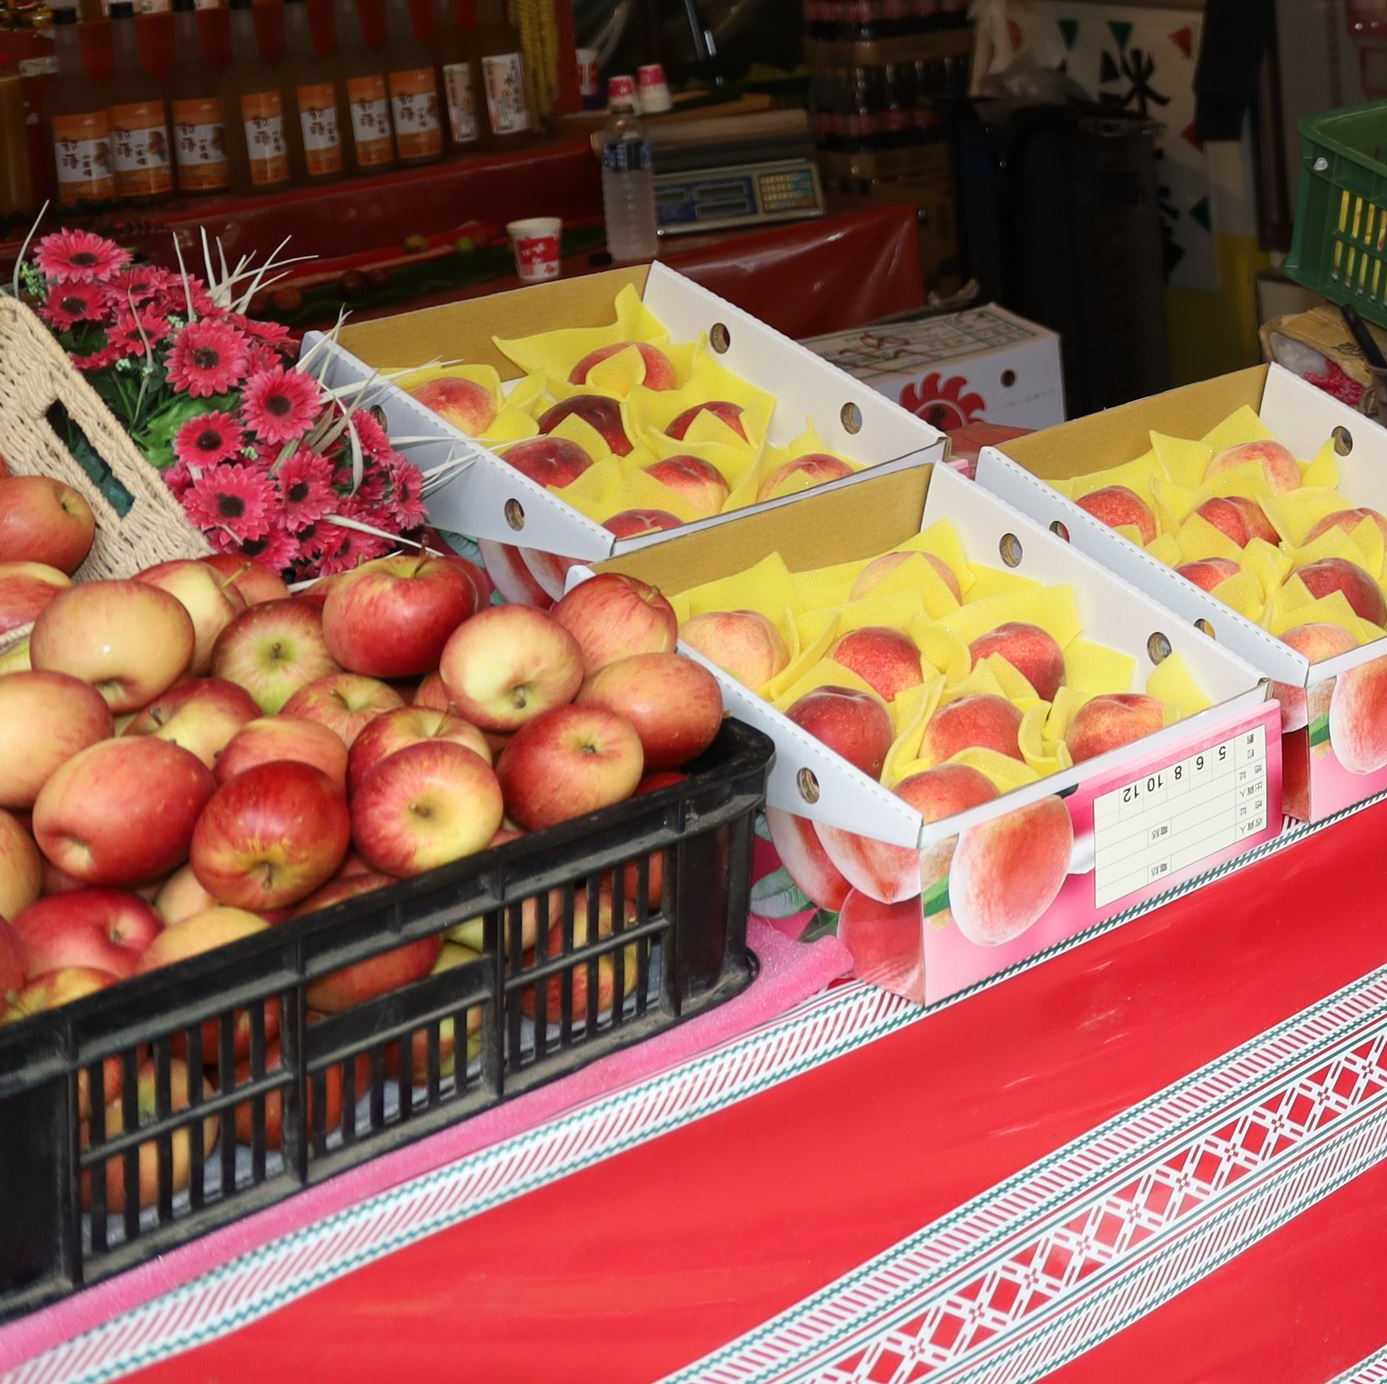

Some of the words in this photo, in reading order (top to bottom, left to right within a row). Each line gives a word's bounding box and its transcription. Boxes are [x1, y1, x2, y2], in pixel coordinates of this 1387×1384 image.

[1218, 745, 1226, 761] 5
[1196, 756, 1204, 771] 6
[1174, 765, 1183, 780] 8
[1147, 773, 1164, 792] 10
[1123, 784, 1140, 803] 12
